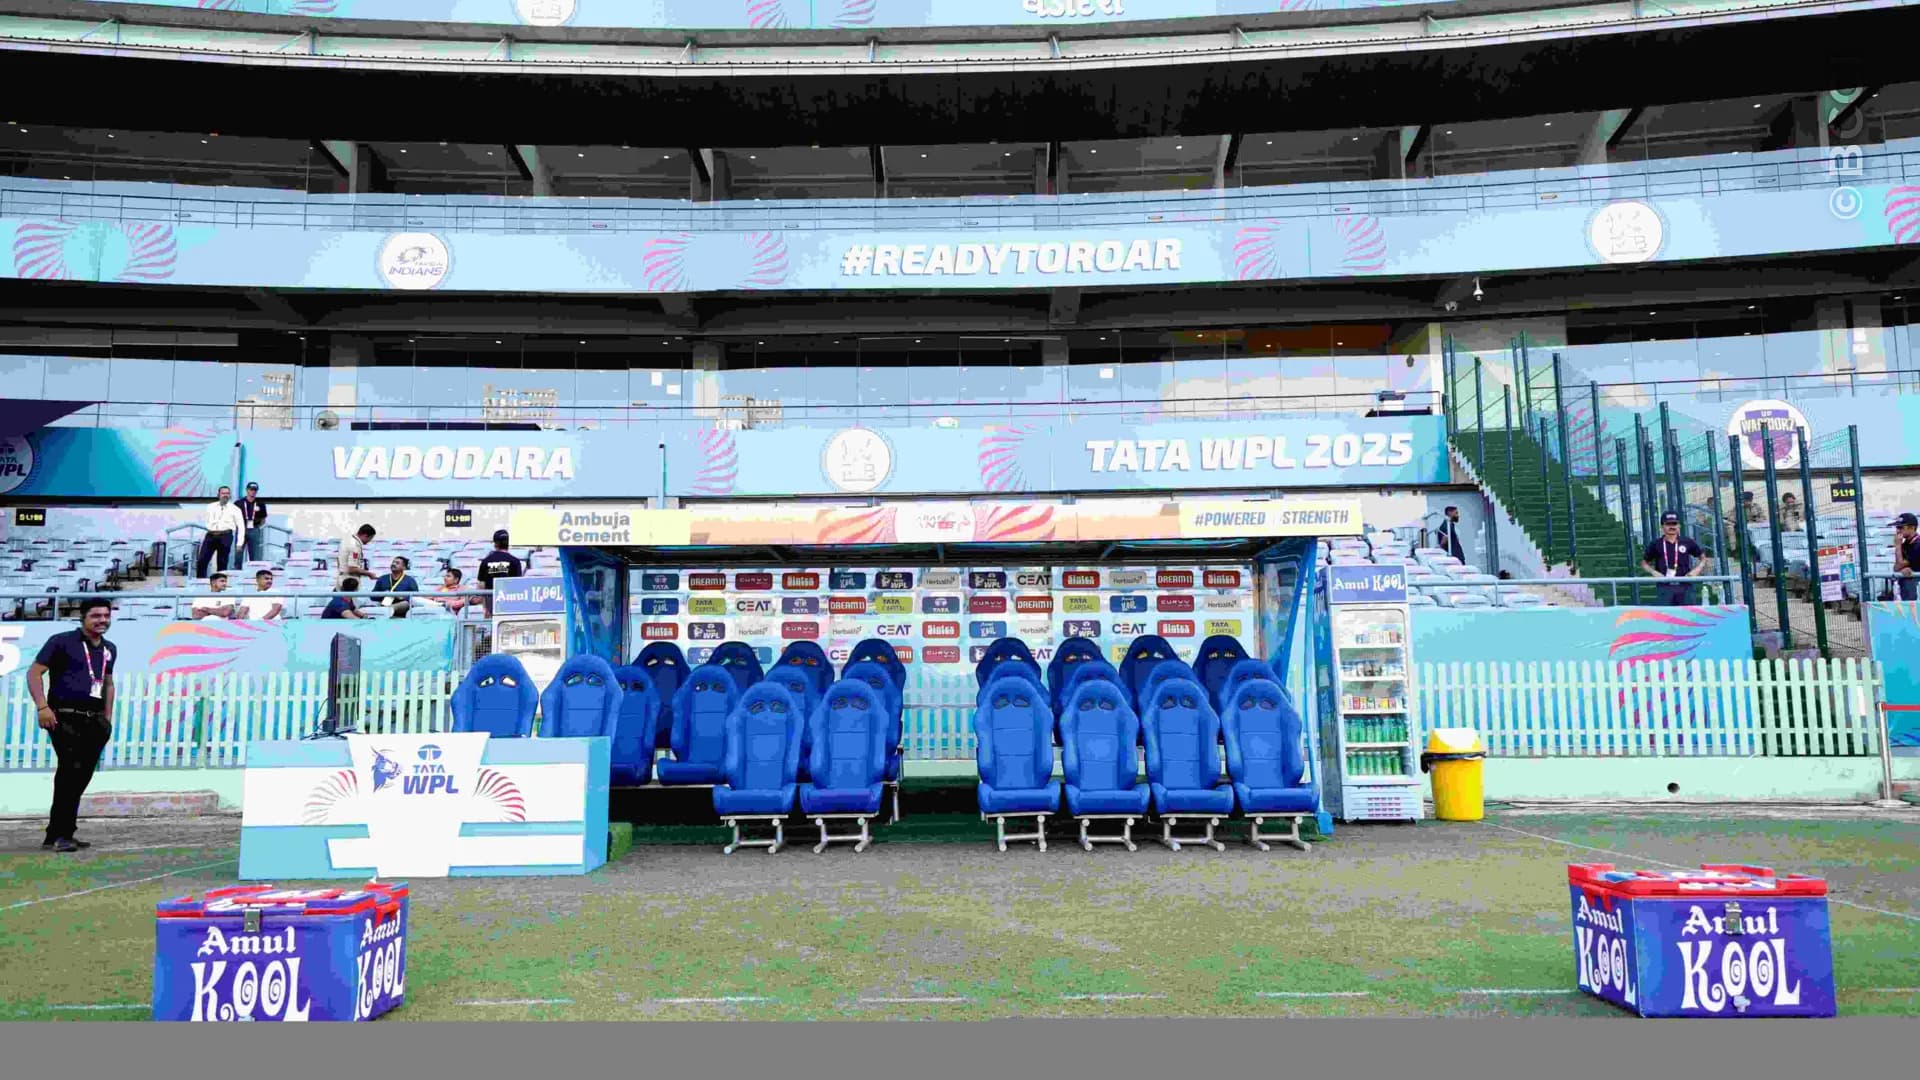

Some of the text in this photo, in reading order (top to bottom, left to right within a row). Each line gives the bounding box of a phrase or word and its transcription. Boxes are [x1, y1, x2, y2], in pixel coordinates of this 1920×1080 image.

[840, 238, 1182, 276] #READYTOROAR
[388, 266, 444, 276] INDIANS
[1085, 432, 1414, 472] TATA WPL 2025
[332, 446, 575, 480] VADODARA
[560, 512, 630, 527] Ambuja
[1195, 510, 1349, 526] #POWERED STRENGTH
[558, 528, 631, 544] Cement
[1017, 574, 1052, 586] CEAT
[1333, 573, 1405, 591] Amul KOOL
[495, 585, 563, 602] Amul KOOL
[736, 600, 771, 612] CEAT
[876, 624, 912, 636] CEAT
[1112, 624, 1146, 634] CEAT
[830, 650, 848, 661] CE
[1029, 648, 1053, 660] EAT
[412, 764, 446, 773] TATA
[403, 775, 460, 795] WPL
[1577, 895, 1624, 934] Amul
[360, 909, 401, 950] Amul
[197, 926, 296, 957] Amul
[1576, 926, 1636, 1006] KOOL
[353, 937, 405, 1021] KOOL
[1677, 939, 1800, 1012] KOOL
[190, 957, 310, 1021] KOOL
